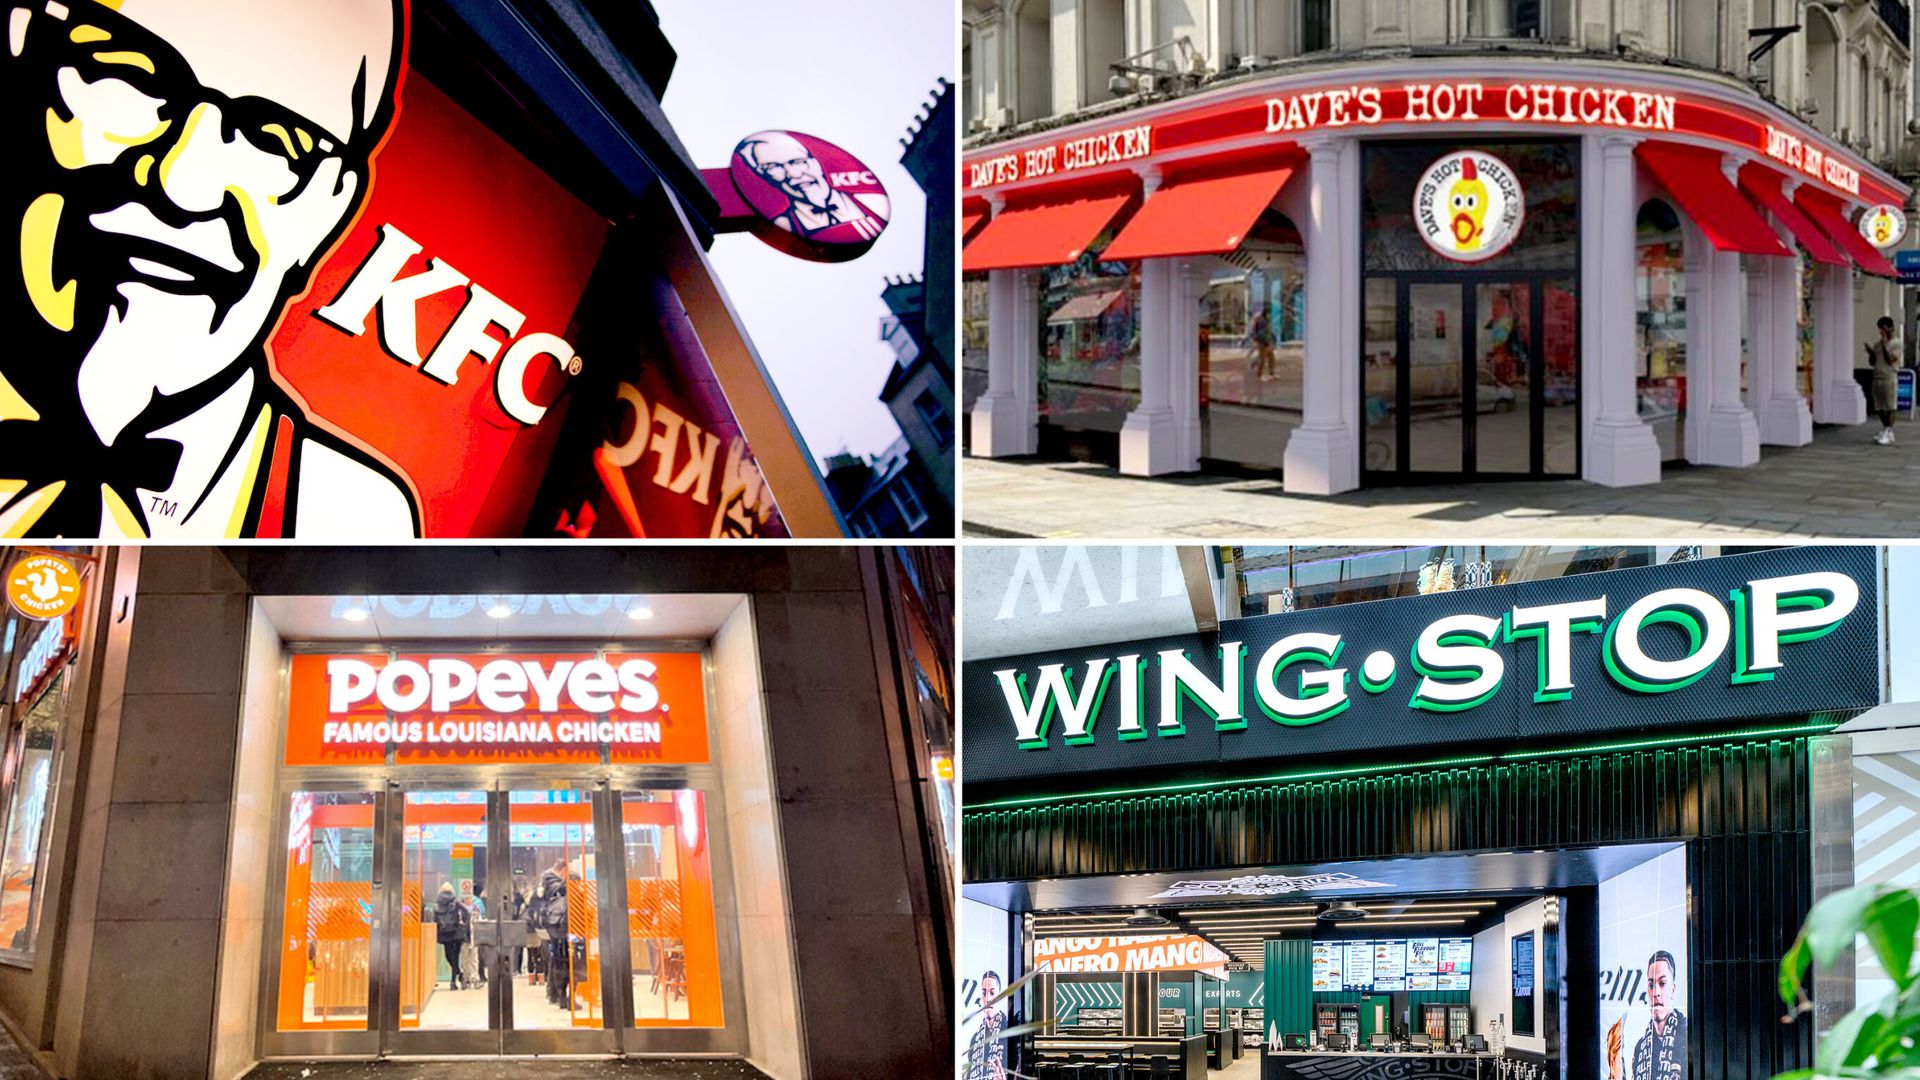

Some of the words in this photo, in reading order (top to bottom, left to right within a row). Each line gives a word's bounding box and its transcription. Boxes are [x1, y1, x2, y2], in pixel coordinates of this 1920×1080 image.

[1264, 86, 1382, 133] DAVE'S
[1404, 83, 1482, 121] HOT
[1505, 84, 1676, 130] CHICKEN
[970, 154, 1018, 188] DAVE'S
[1025, 146, 1056, 178] HOT
[1063, 125, 1151, 170] CHICKEN
[829, 170, 877, 187] KFC
[1419, 182, 1441, 236] DAVE'S
[1431, 158, 1460, 184] HOT
[1477, 158, 1519, 230] CHICKEN
[150, 496, 178, 517] TM
[26, 558, 69, 575] POPEYES
[19, 593, 65, 611] CHICKEN
[323, 721, 423, 744] FAMOUS
[427, 721, 554, 743] LOUISIANA
[557, 721, 662, 743] CHICKEN
[1205, 990, 1241, 998] EXPRTS
